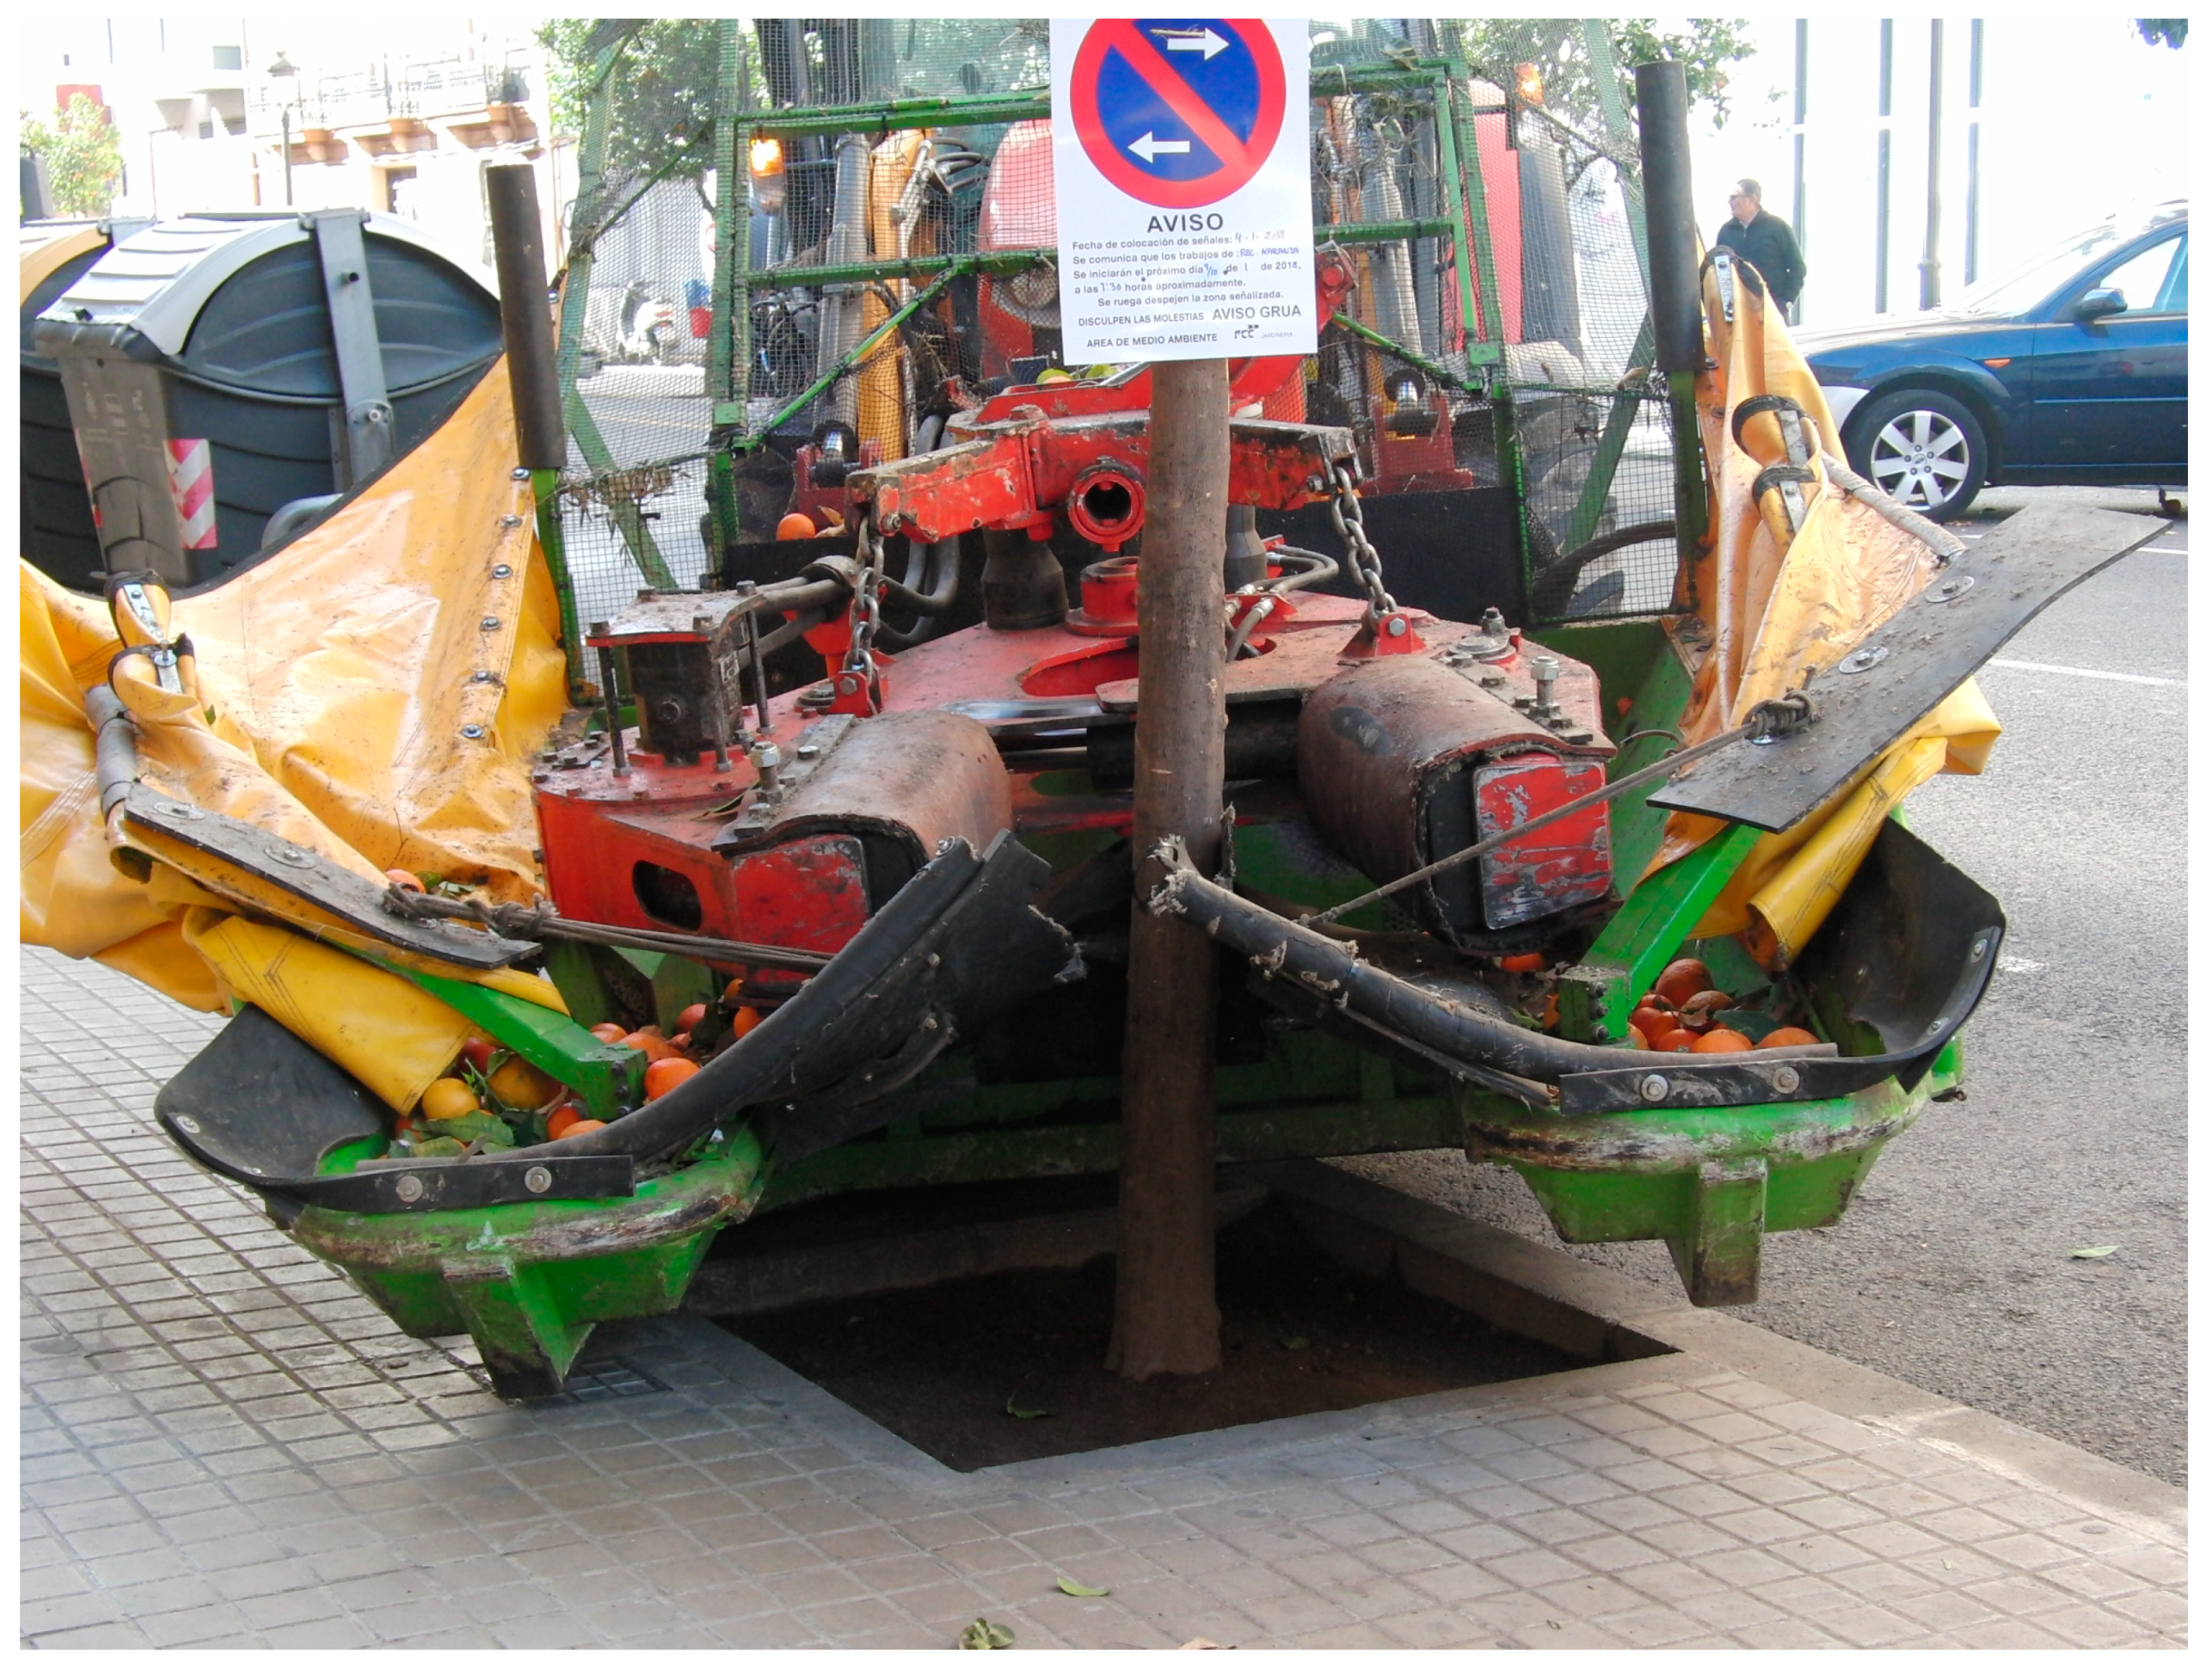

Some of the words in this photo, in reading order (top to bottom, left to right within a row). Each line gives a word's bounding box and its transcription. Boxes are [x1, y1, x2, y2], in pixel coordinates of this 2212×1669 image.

[1147, 214, 1224, 233] AVISO
[1072, 242, 1103, 250] Fecha
[1121, 237, 1174, 249] colocación
[1192, 236, 1232, 245] señales:
[1073, 256, 1085, 265] Se
[1089, 254, 1137, 264] comunica
[1140, 254, 1158, 263] que
[1179, 251, 1219, 260] trabajos
[1221, 249, 1233, 258] de
[1073, 270, 1086, 279] Se
[1090, 268, 1132, 279] iniciarán
[1146, 267, 1185, 277] próximo
[1226, 263, 1238, 272] de
[1125, 283, 1152, 291] horas
[1156, 280, 1245, 291] aproximadamente.
[1098, 298, 1110, 306] Se
[1114, 298, 1142, 307] ruega
[1145, 295, 1189, 304] despejen
[1230, 291, 1284, 300] señalizada.
[1078, 316, 1131, 327] DISCULPEN
[1134, 315, 1151, 323] LAS
[1153, 312, 1204, 322] MOLESTIAS
[1213, 306, 1256, 320] AVISO
[1260, 304, 1302, 318] GRUA
[1087, 339, 1113, 347] AREA
[1133, 336, 1165, 346] MEDIO
[1168, 334, 1218, 344] AMBIENTE
